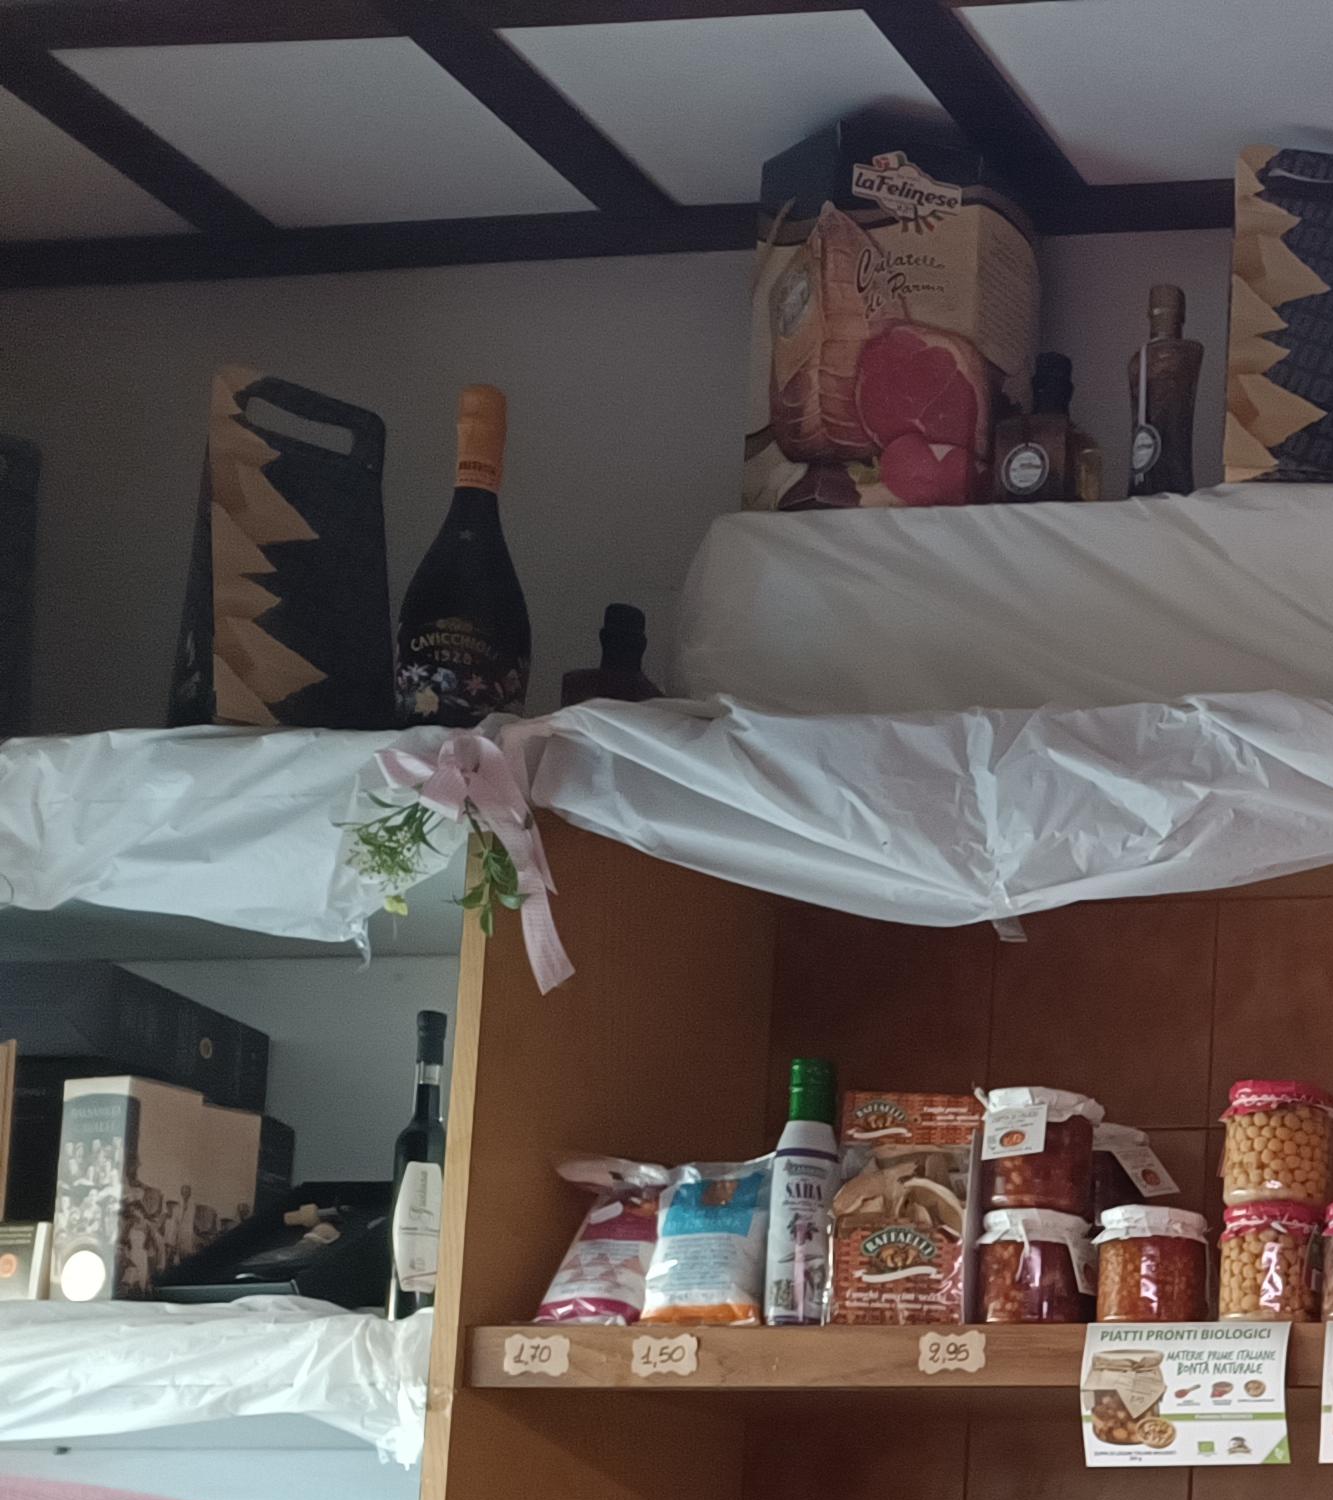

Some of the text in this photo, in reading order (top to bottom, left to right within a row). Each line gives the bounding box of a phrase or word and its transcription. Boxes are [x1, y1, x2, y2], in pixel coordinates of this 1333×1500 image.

[1100, 1328, 1271, 1341] PIATTI PRONTI BIOLOGICI
[641, 1347, 687, 1370] 1,50
[928, 1344, 970, 1364] 2,95
[1212, 1362, 1263, 1374] NATURALE
